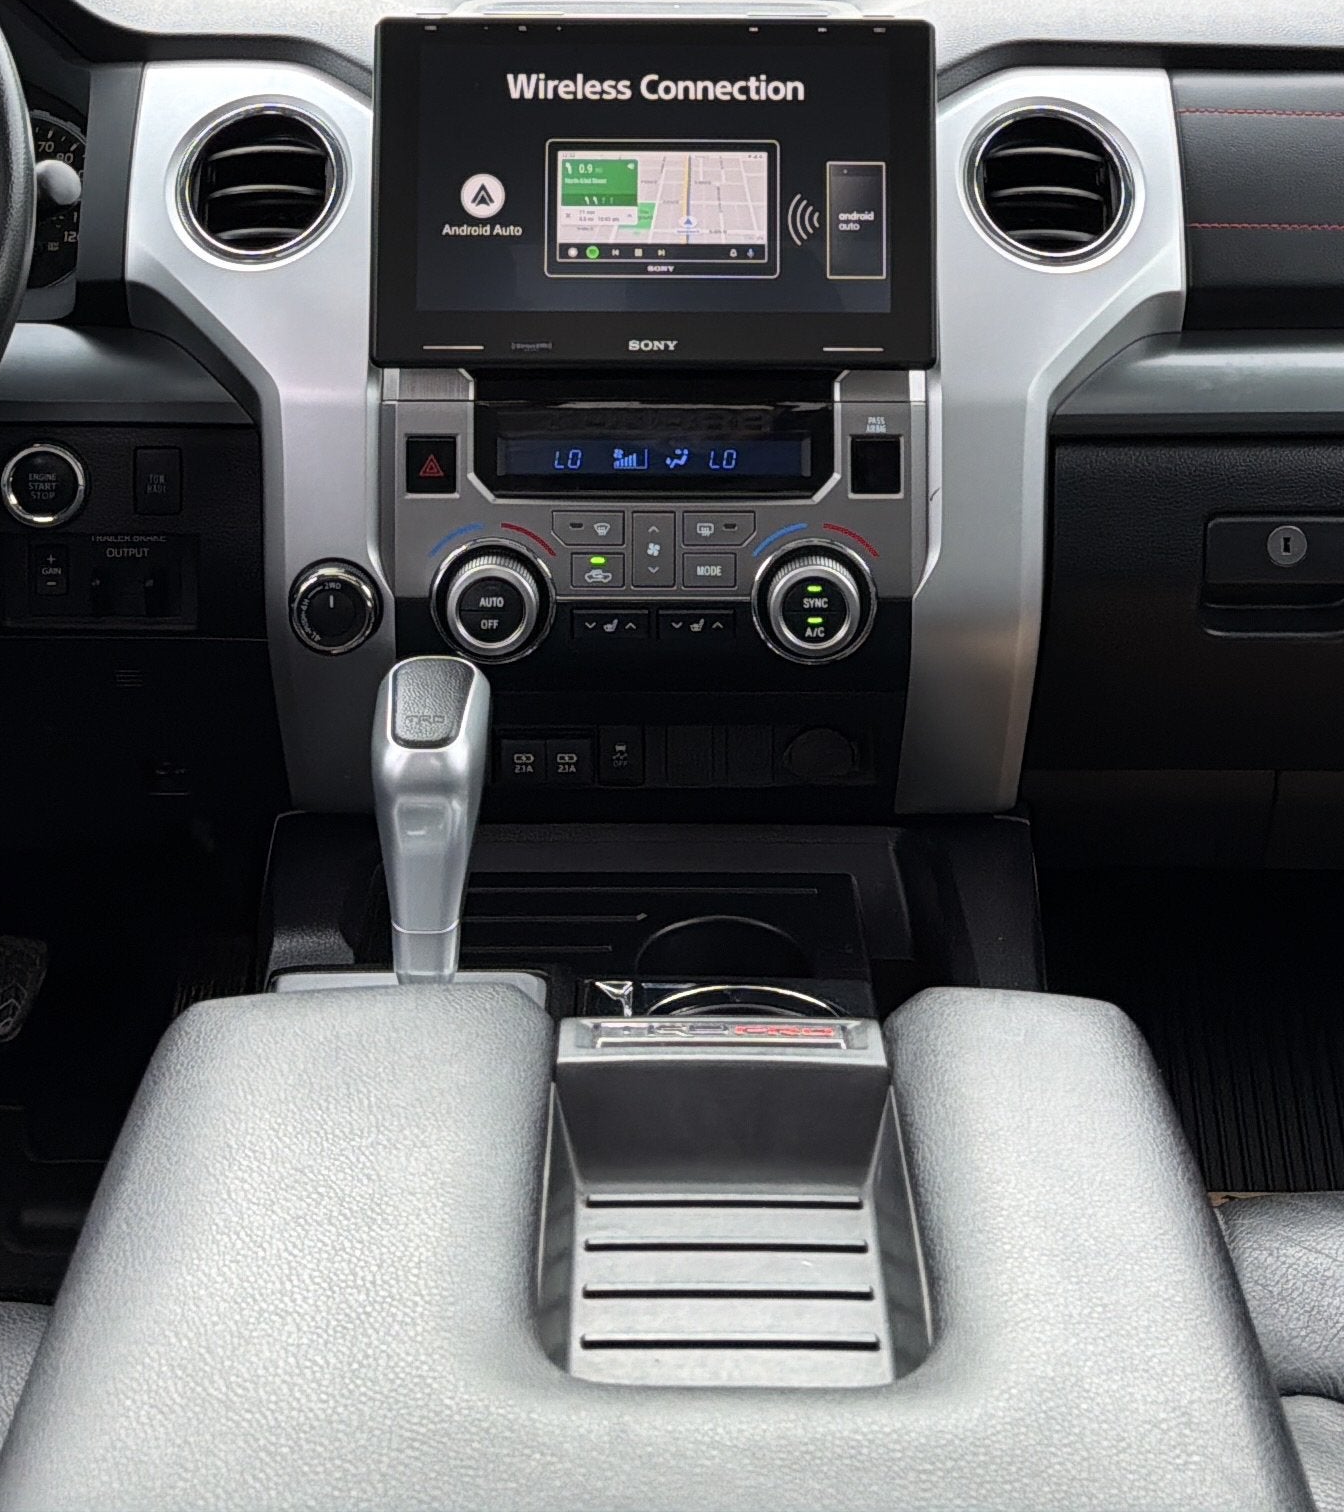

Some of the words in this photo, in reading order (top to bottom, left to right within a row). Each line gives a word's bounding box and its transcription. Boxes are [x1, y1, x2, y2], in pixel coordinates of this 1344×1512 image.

[506, 73, 632, 100] Wireless
[640, 74, 805, 101] Connection
[37, 141, 54, 153] 70
[579, 163, 593, 174] 0.9
[838, 211, 874, 221] android
[441, 224, 491, 236] Android
[493, 224, 522, 236] Auto
[838, 223, 860, 231] auto
[64, 231, 79, 242] 12
[628, 339, 679, 351] SONY
[867, 416, 886, 424] PASS
[554, 450, 582, 469] LO
[709, 450, 737, 469] LO
[28, 473, 57, 481] ENGINE
[28, 482, 57, 491] START
[30, 491, 56, 500] STOP
[106, 548, 160, 558] OUTPUT
[41, 567, 62, 575] GAIN
[696, 566, 722, 577] MODE
[323, 582, 342, 590] 2WD
[479, 597, 505, 608] AUTO
[803, 598, 828, 609] SYNC
[480, 619, 499, 630] OFF
[804, 626, 825, 638] A/C
